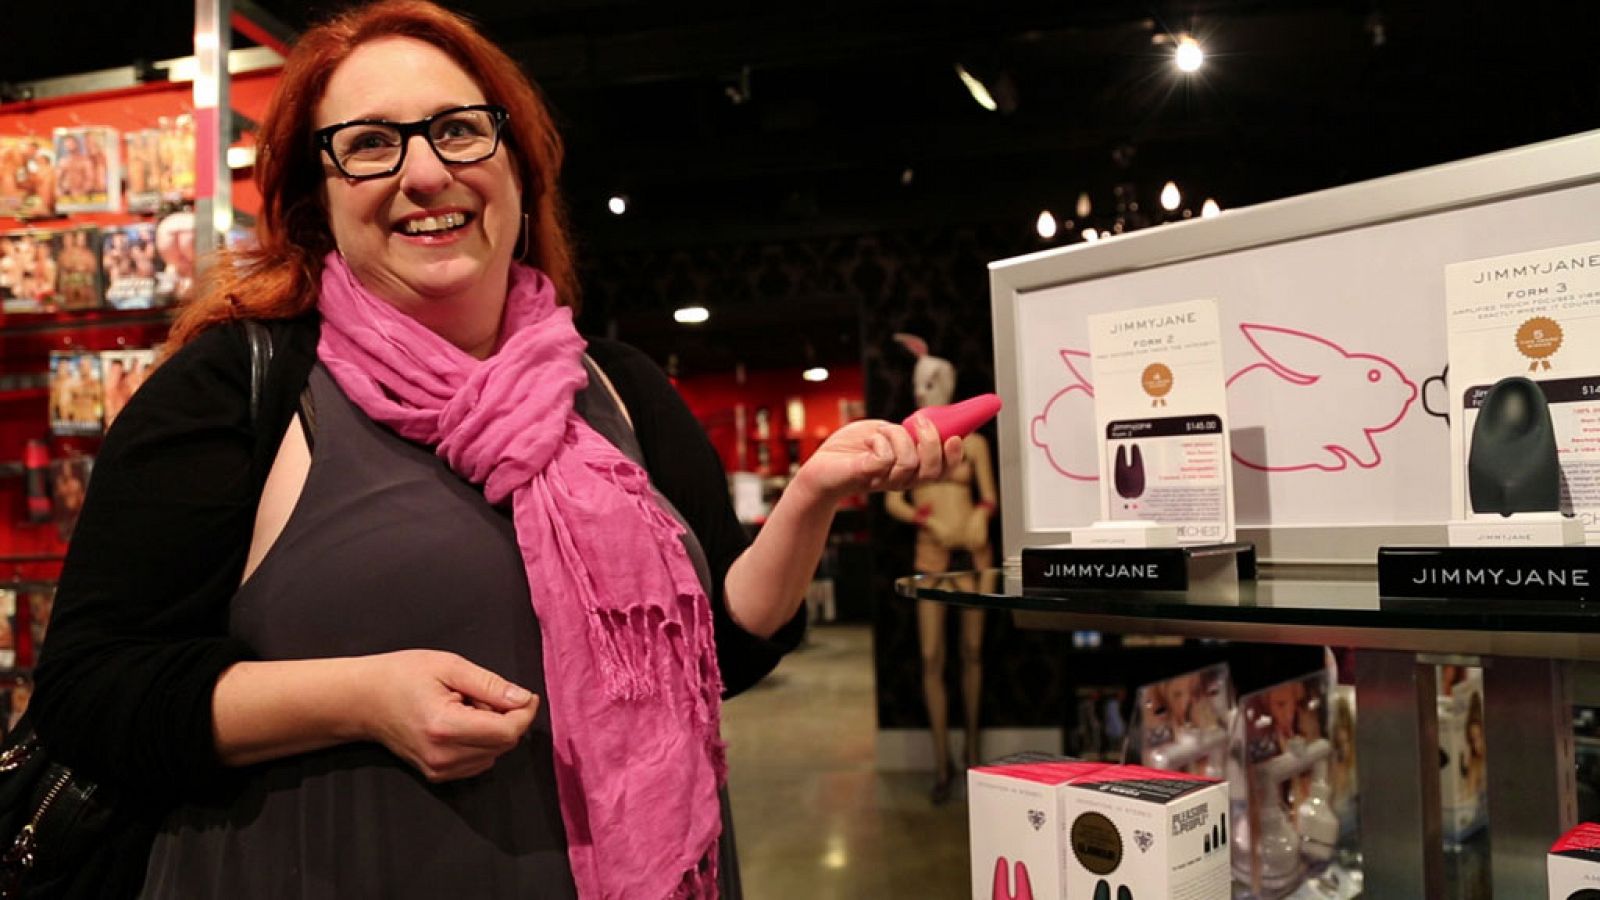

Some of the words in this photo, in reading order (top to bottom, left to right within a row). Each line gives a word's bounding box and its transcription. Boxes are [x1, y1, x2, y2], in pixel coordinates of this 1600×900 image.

[1473, 254, 1600, 284] JIMMYJANE
[1507, 287, 1548, 299] FORM
[1556, 282, 1567, 293] 3
[1110, 312, 1196, 334] JIMMYJANE
[1044, 564, 1159, 578] JIMMYJANE
[1412, 568, 1590, 587] JIMMYJANE
